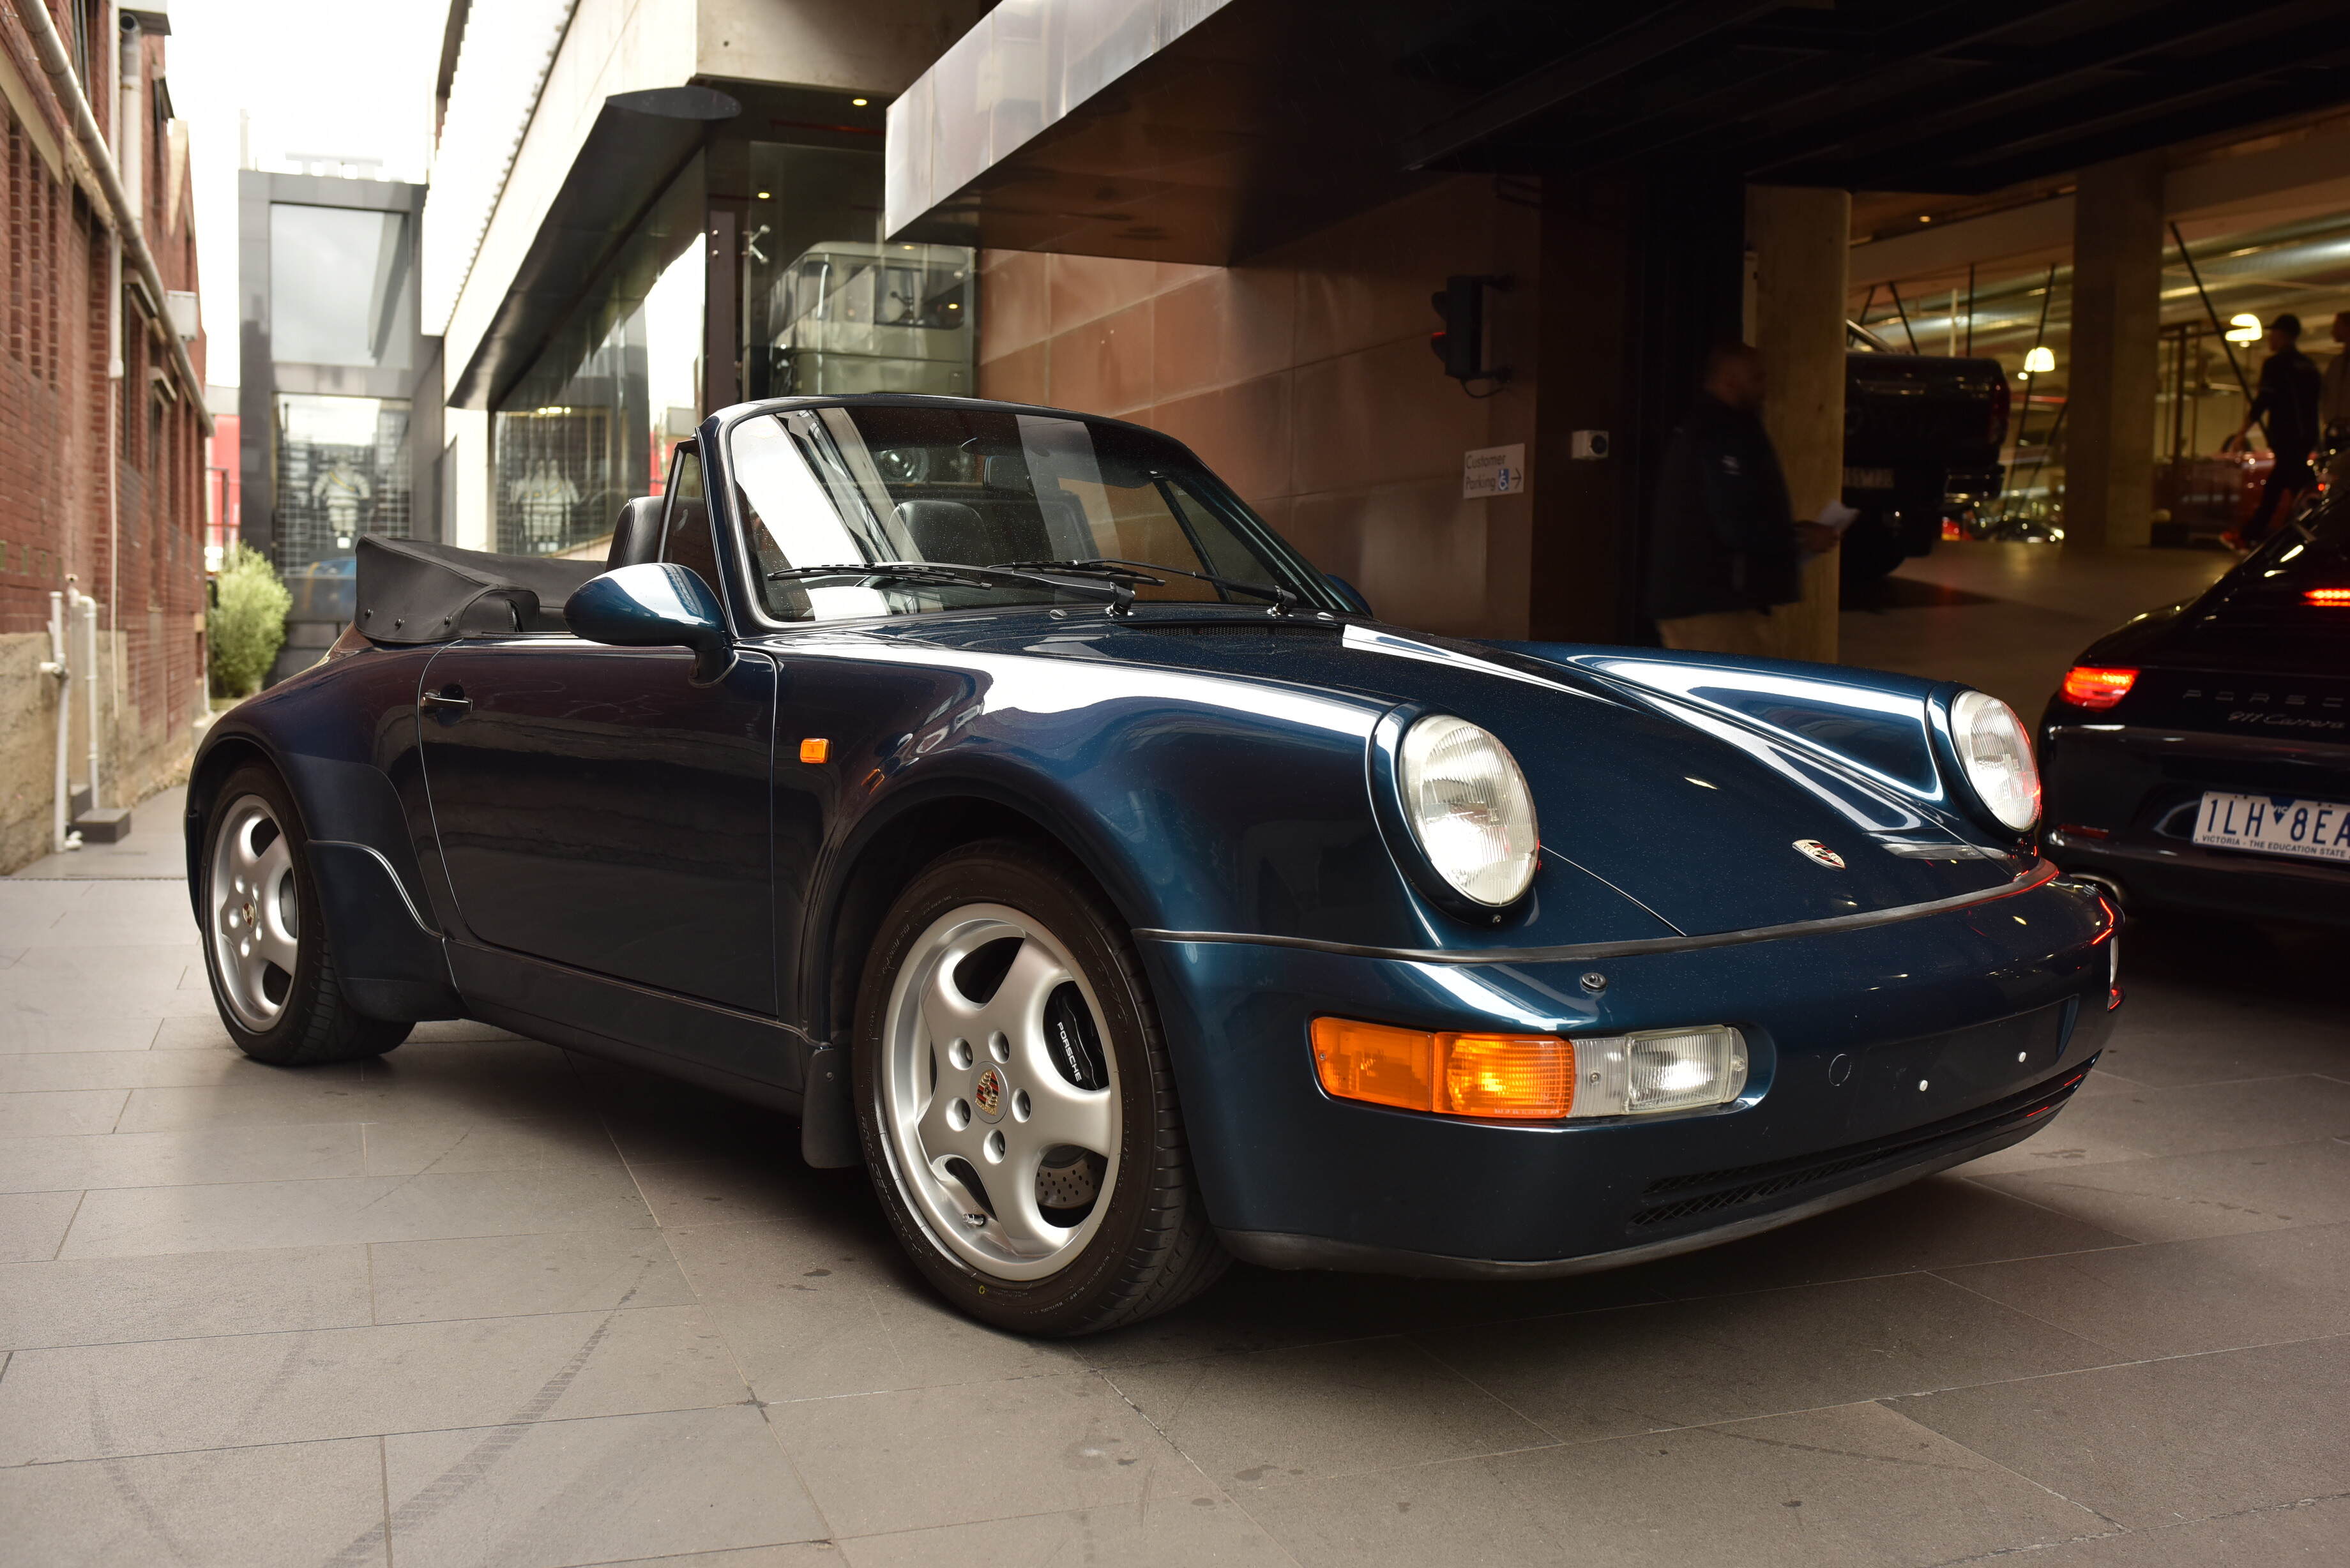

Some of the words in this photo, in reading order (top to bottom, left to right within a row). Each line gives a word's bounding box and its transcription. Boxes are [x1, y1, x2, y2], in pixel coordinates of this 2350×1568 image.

[1466, 455, 1506, 469] Customer
[1466, 474, 1496, 491] Parking
[2264, 713, 2345, 728] Carrera
[2202, 835, 2240, 846] VICTORIA
[2250, 840, 2266, 848] THE
[2268, 841, 2317, 854] EDUCATION
[2319, 848, 2346, 858] STATE
[1058, 1021, 1082, 1082] PORSCHE
